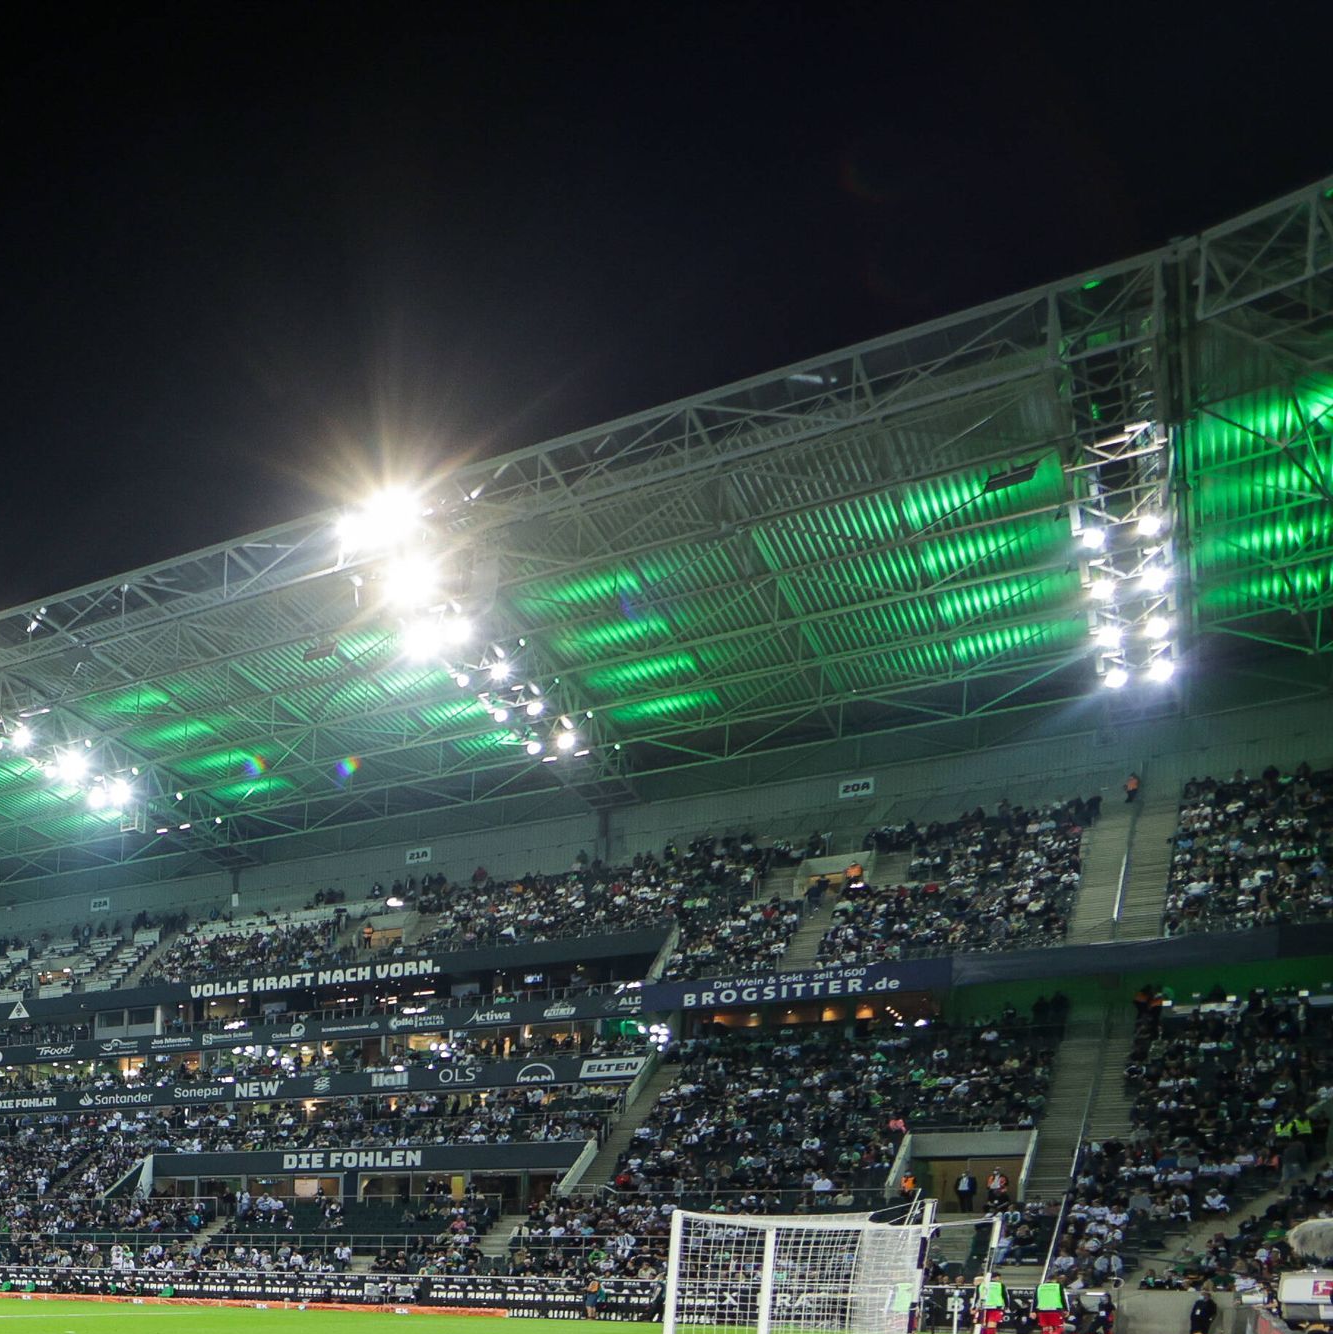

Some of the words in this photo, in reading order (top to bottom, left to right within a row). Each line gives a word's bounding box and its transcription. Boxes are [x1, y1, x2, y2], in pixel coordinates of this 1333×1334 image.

[842, 782, 871, 796] 20A
[190, 979, 248, 999] VOLLE
[252, 972, 315, 991] KRAFT
[317, 966, 370, 985] NACH
[375, 959, 441, 979] VORN.
[713, 980, 733, 990] Der
[736, 977, 764, 987] Wein
[767, 976, 777, 985] &
[779, 973, 803, 984] Sekt
[813, 970, 834, 981] seit
[837, 968, 866, 979] 1600
[683, 977, 901, 1007] BROGSITTER.de
[464, 1009, 511, 1025] Actiwa
[36, 1044, 75, 1057] Troost
[586, 1061, 638, 1074] ELTEN
[438, 1068, 475, 1083] OLS
[94, 1093, 153, 1105] Santander
[174, 1086, 224, 1100] Sonepar
[15, 1097, 57, 1108] FOHLEN
[283, 1153, 324, 1169] DIE
[329, 1150, 422, 1168] FOHLEN
